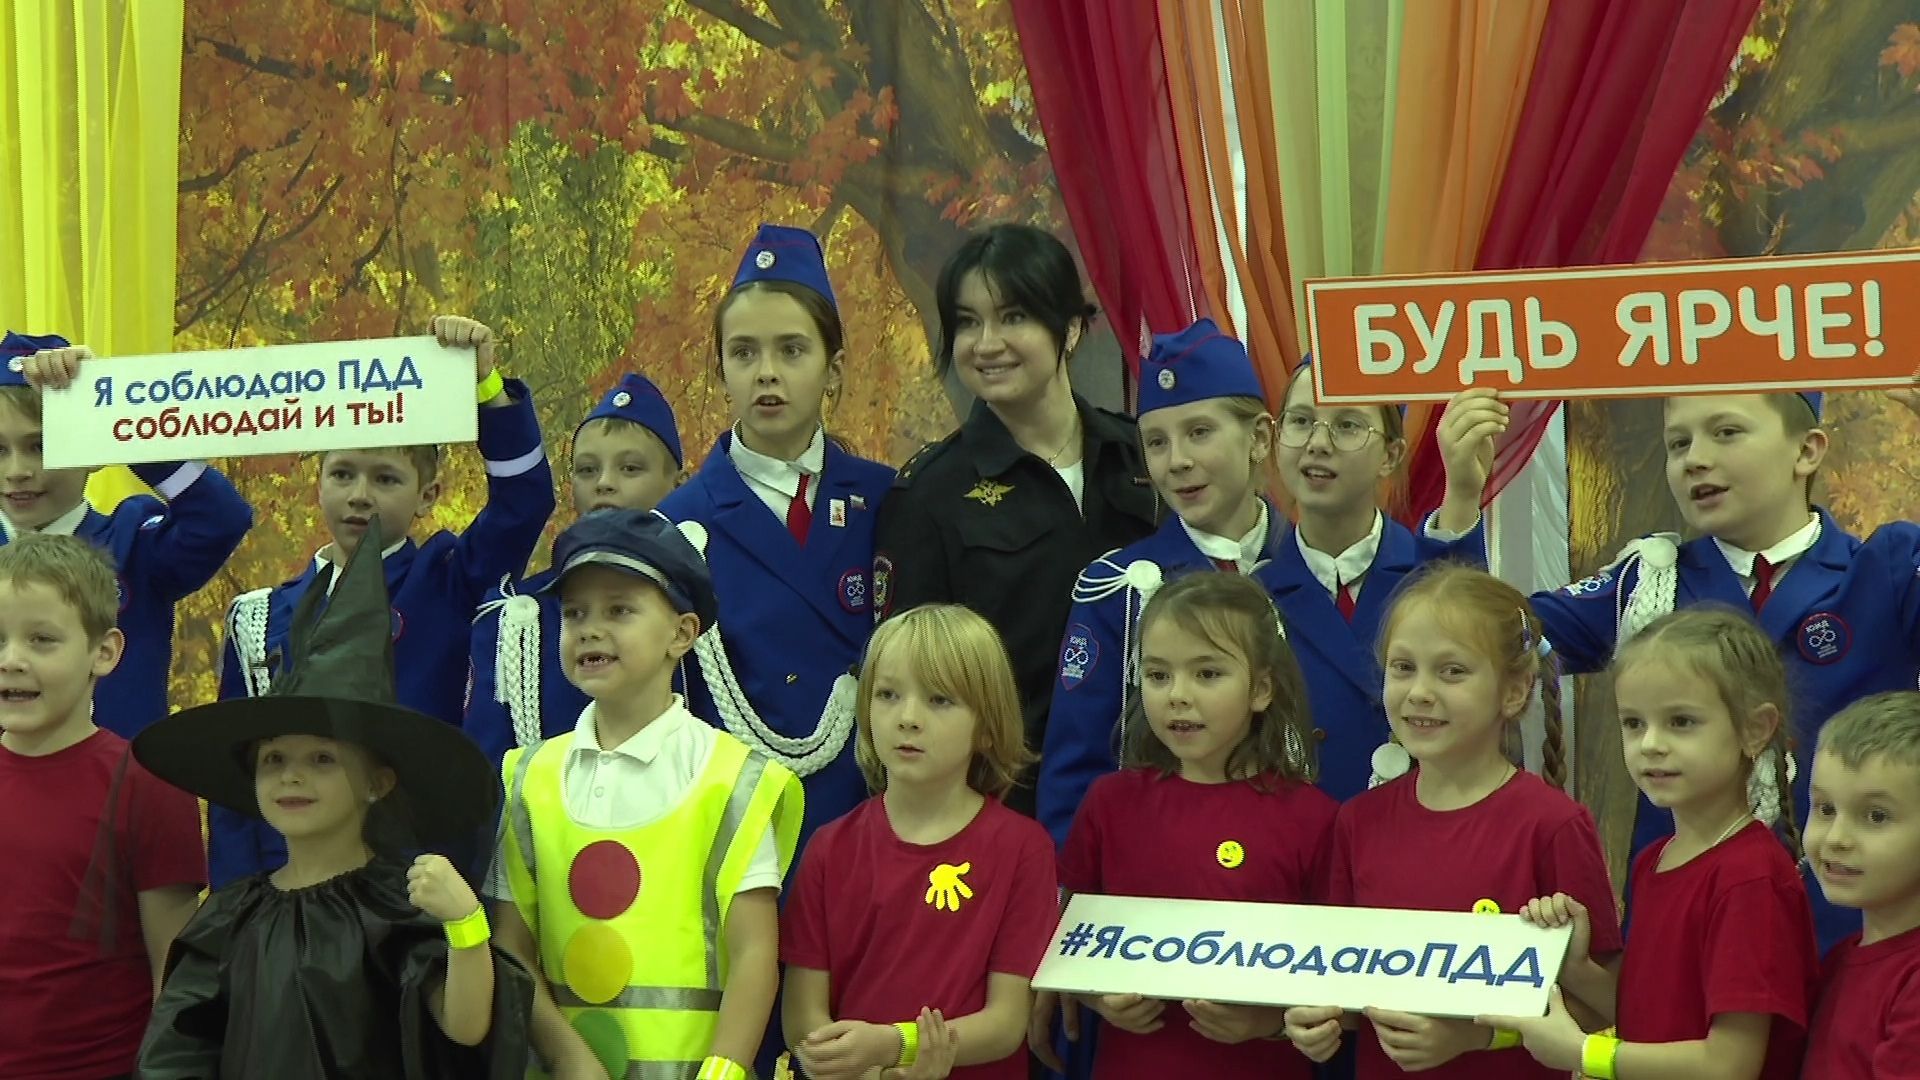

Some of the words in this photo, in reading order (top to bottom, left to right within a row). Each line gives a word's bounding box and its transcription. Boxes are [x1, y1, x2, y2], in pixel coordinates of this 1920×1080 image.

[1354, 297, 1578, 385] БУДЬ
[1615, 280, 1885, 367] ЯРЧЕ!
[94, 376, 113, 406] Я
[125, 368, 326, 404] соблюдаю
[338, 356, 423, 391] ПДД
[112, 398, 303, 442] соблюдай
[315, 404, 335, 428] и
[346, 392, 404, 426] ты!
[1058, 922, 1546, 989] #ЯсоблюдаюПДД
